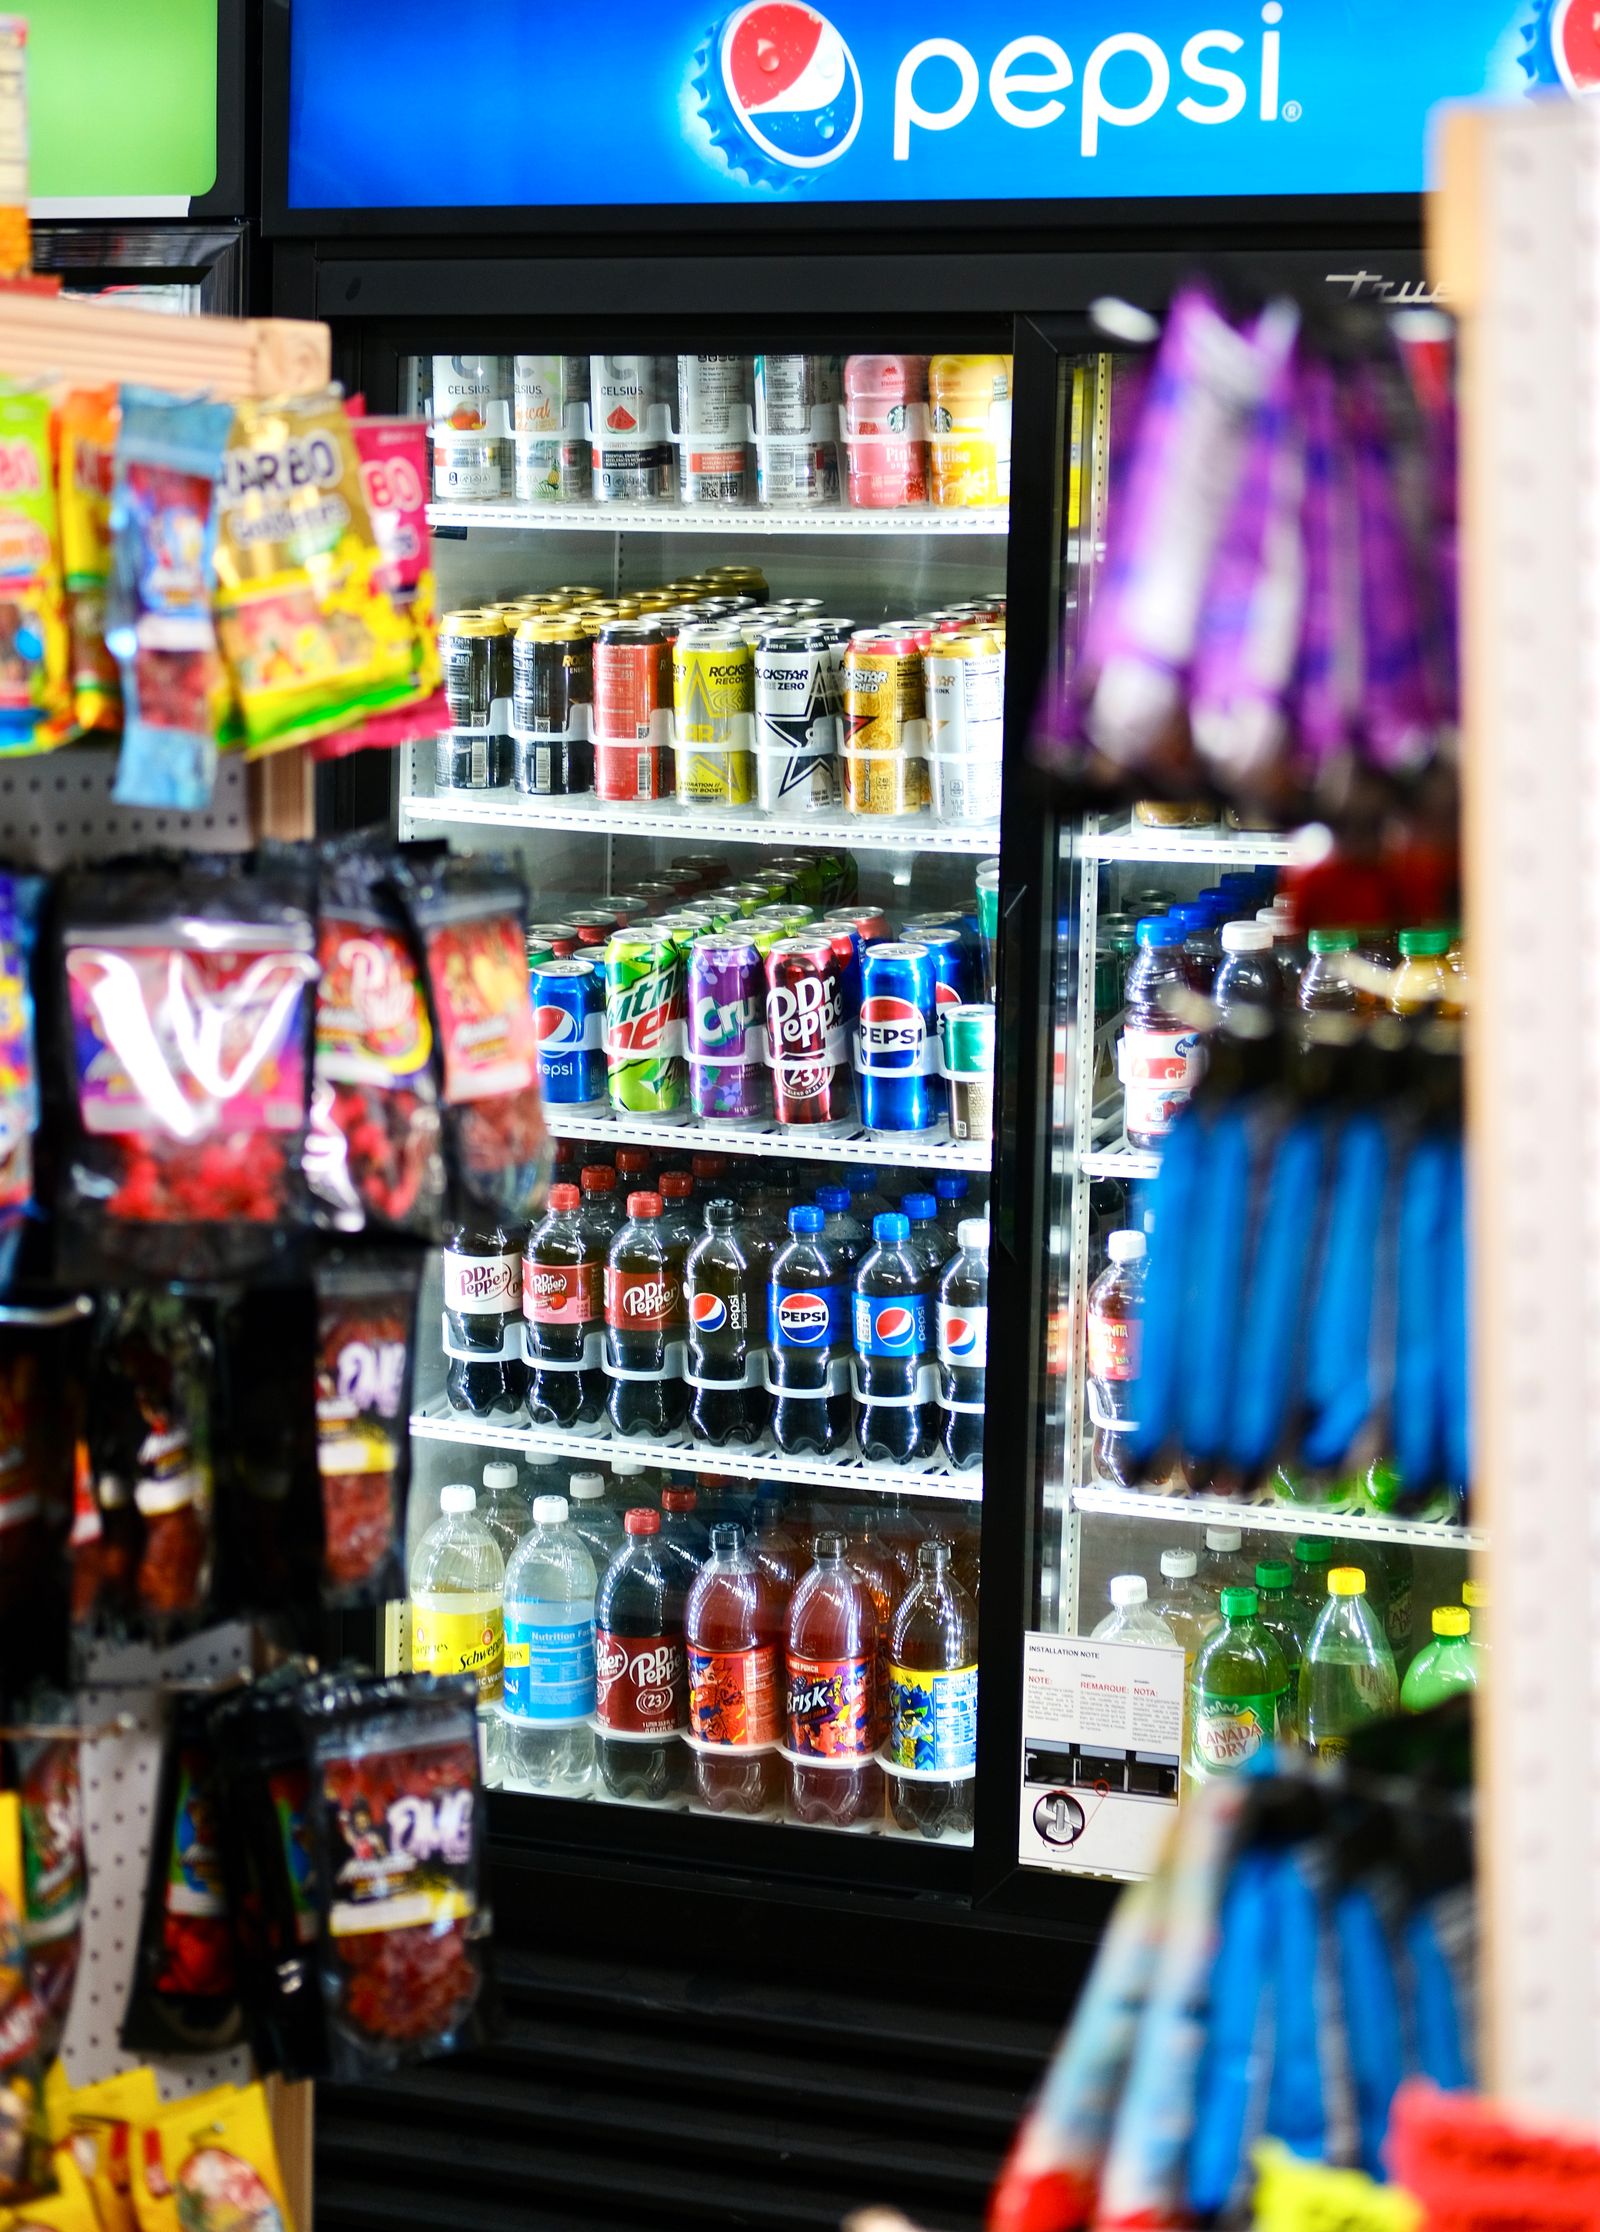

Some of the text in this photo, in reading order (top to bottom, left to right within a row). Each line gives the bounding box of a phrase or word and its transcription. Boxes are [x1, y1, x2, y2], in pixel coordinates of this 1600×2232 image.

[893, 1, 1282, 161] pepsi
[448, 385, 491, 396] CELSIUS
[600, 385, 644, 397] CELSIUS
[709, 666, 748, 677] ROCKS
[715, 676, 746, 686] RECOV
[777, 683, 804, 691] ZERO
[795, 975, 836, 1017] Dr
[696, 996, 758, 1044] Cru
[767, 985, 843, 1048] Peppe
[861, 1027, 922, 1045] PEPSI
[789, 1067, 815, 1088] 23
[459, 1267, 509, 1298] Pepper
[473, 1265, 495, 1282] Dr
[644, 1281, 666, 1299] Dr
[629, 1286, 677, 1317] Pepper
[728, 1294, 742, 1330] pepsi
[781, 1311, 827, 1323] PEPSI
[918, 1305, 926, 1342] pepsi
[531, 1632, 576, 1641] Nutrition
[655, 1645, 677, 1668] Dr
[1029, 1645, 1100, 1659] INSTALLATION NOTE
[637, 1652, 684, 1688] Peppe
[800, 1663, 819, 1673] PUNCH
[1028, 1675, 1053, 1686] NOTE:
[1080, 1681, 1130, 1694] REMARQUE:
[647, 1694, 662, 1708] 23
[1133, 1687, 1159, 1697] NOTA:
[1203, 1723, 1264, 1746] ANADA
[1215, 1742, 1250, 1760] DRY
